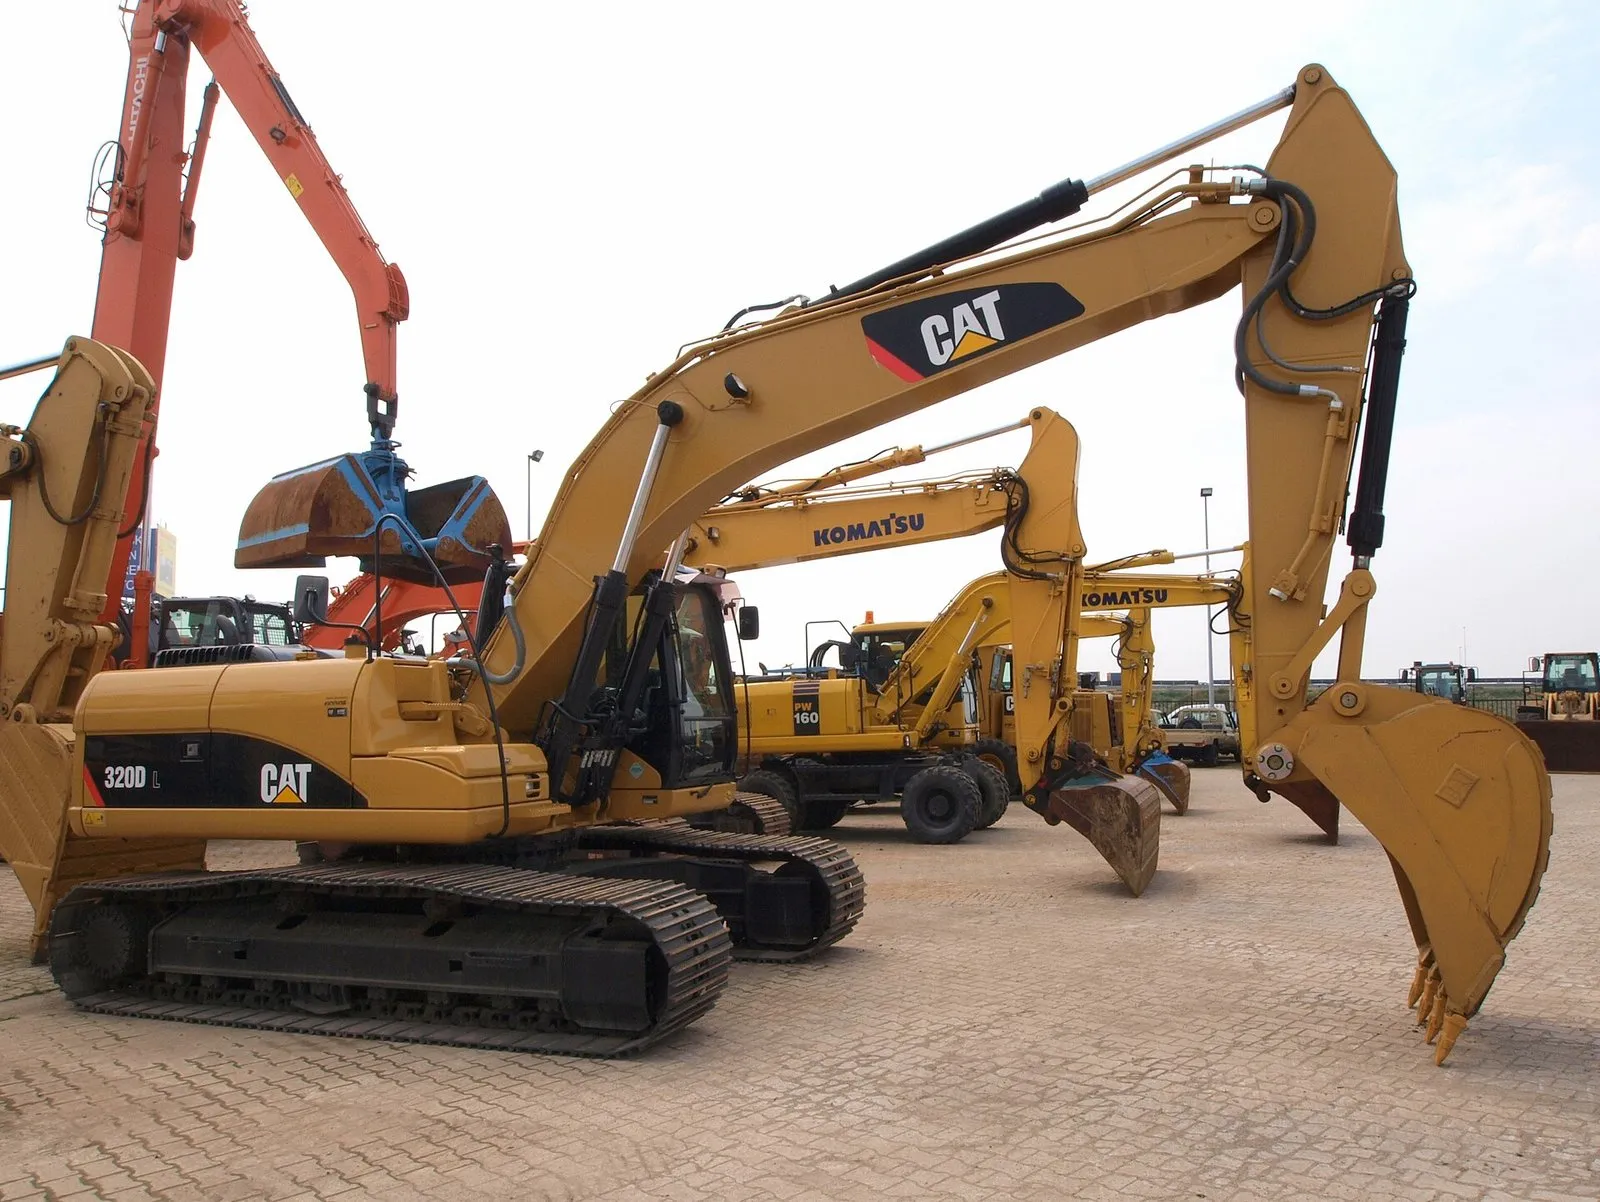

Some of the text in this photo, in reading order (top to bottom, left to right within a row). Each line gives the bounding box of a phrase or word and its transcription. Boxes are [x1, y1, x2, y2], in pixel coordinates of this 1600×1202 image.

[920, 289, 1005, 366] CAT
[813, 512, 925, 547] KOMATSU
[794, 702, 812, 711] PW
[794, 711, 819, 724] 160
[104, 765, 161, 789] 320D L
[260, 763, 312, 803] CAT
